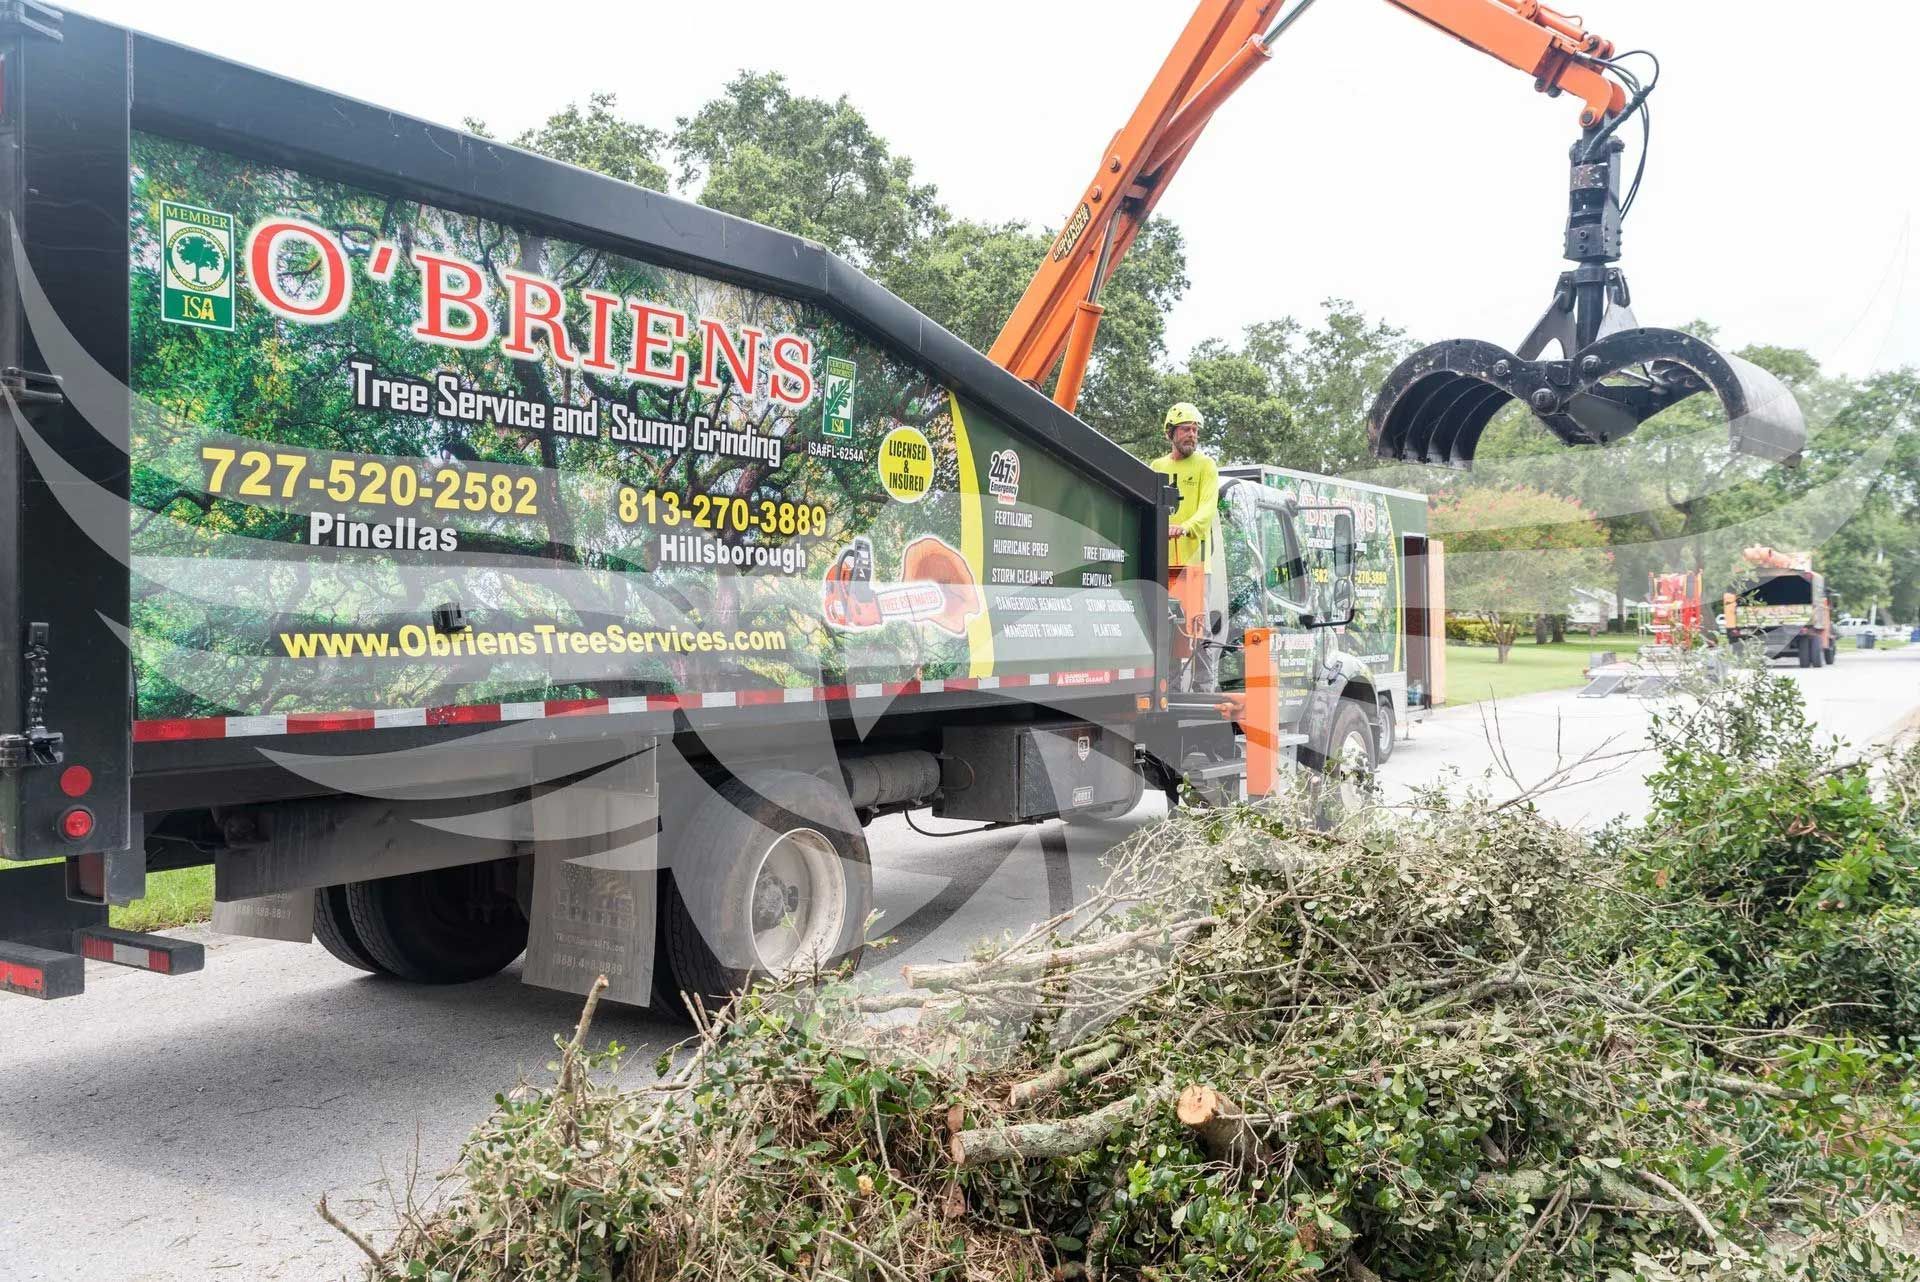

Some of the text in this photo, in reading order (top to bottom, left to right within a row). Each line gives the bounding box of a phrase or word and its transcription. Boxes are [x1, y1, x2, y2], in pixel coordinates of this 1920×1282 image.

[166, 206, 228, 229] MEMBER
[182, 294, 216, 321] ISA
[249, 220, 815, 406] O'BRIENS
[351, 362, 781, 468] Tree Service and Stump Grinding
[831, 418, 845, 434] ISA
[808, 441, 865, 463] ISA#FL-6254A
[889, 440, 927, 461] LICENSED
[903, 459, 910, 474] &
[203, 447, 538, 515] 727-520-2582
[889, 472, 924, 492] INSURED
[618, 487, 826, 537] 813-270-3889
[994, 510, 1033, 528] FERTILIZING
[309, 512, 458, 552] Pinellas
[660, 534, 807, 574] Hillsborough
[993, 538, 1049, 558] HURRICANE PREP
[1083, 546, 1125, 563] TREE TRIMMING
[992, 567, 1054, 585] STORM CLEAN-UPS
[1081, 572, 1113, 587] REMOVALS
[280, 624, 786, 659] www.ObriensTreeServices.com
